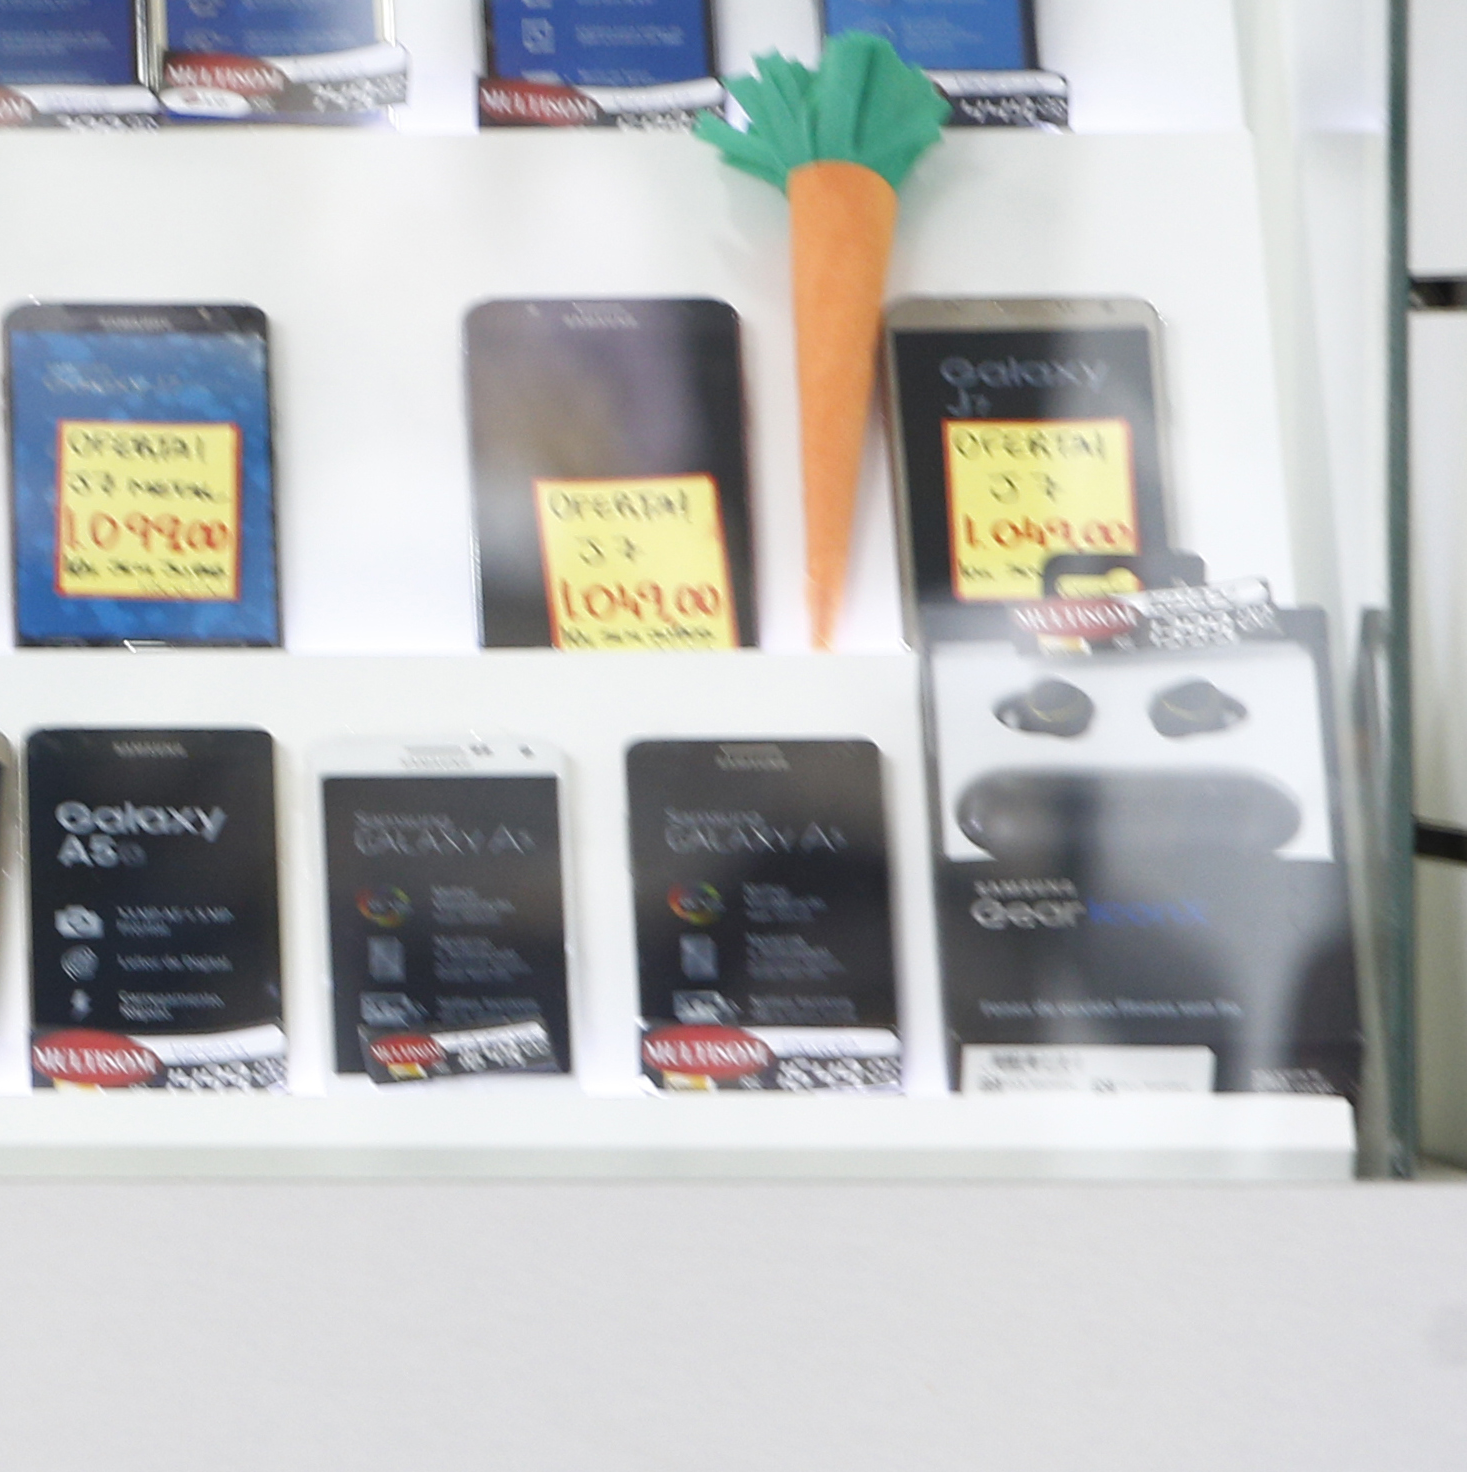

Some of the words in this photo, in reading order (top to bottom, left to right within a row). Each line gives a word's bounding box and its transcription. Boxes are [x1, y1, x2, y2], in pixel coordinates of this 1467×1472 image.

[938, 355, 1109, 392] Galaxy
[54, 799, 228, 844] Galaxy
[973, 878, 1079, 898] SAMSUNG
[969, 897, 1087, 930] Gear
[33, 1045, 158, 1076] MULTISOM
[643, 1038, 772, 1069] MULTISOM
